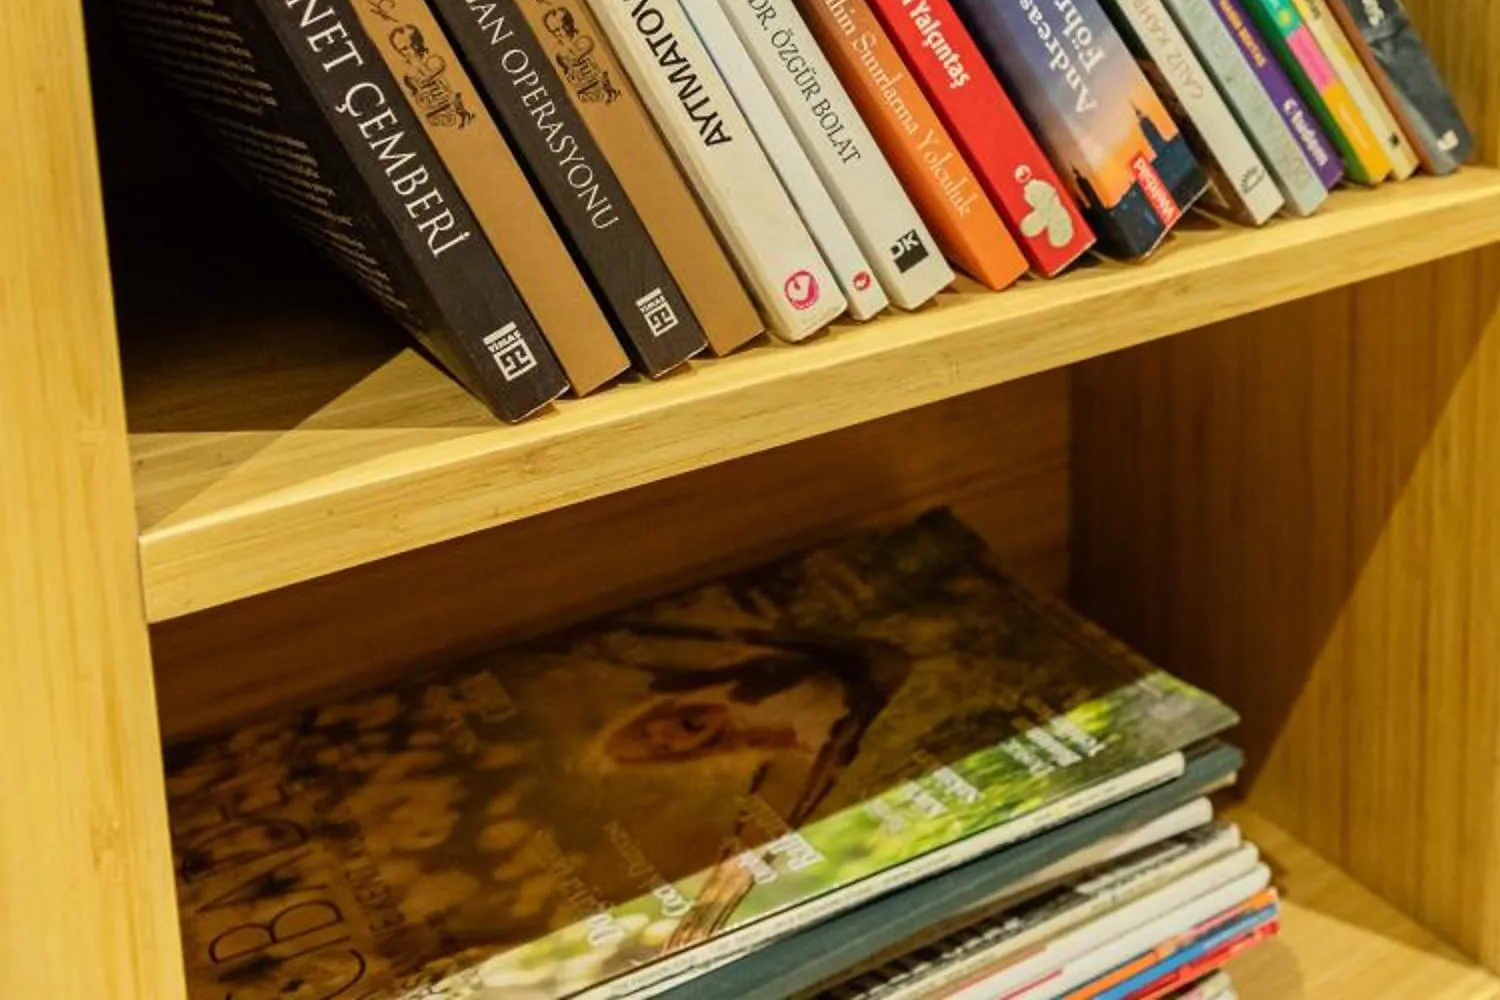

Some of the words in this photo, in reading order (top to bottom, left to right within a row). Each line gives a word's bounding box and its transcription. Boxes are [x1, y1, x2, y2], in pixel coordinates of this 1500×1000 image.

[770, 28, 823, 103] ÖZGÜR
[811, 98, 862, 165] BOLAT
[909, 0, 972, 90] Yalçıntaş
[335, 80, 472, 259] ÇEMBERİ
[500, 47, 620, 231] OPERASYONU
[915, 128, 981, 219] Yolculuk
